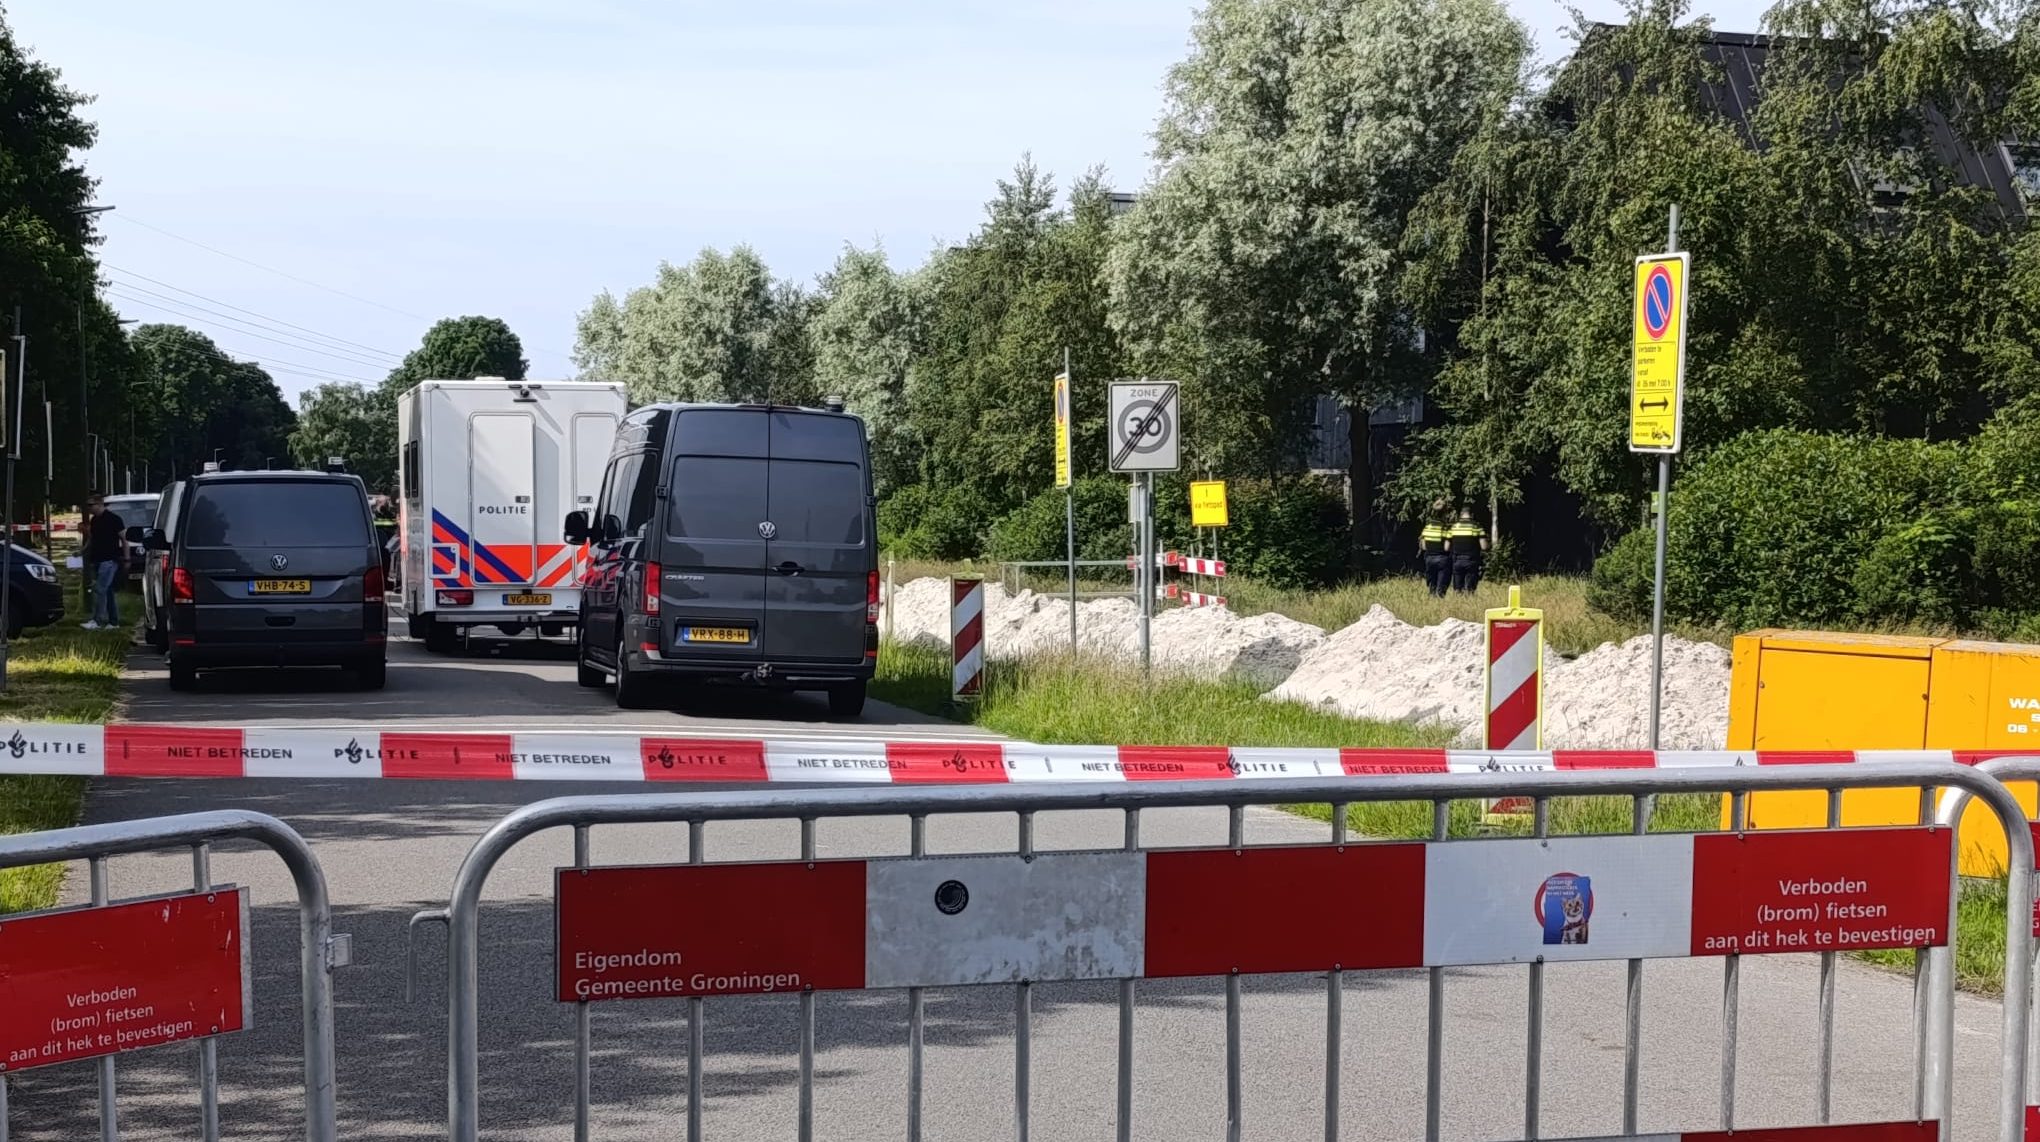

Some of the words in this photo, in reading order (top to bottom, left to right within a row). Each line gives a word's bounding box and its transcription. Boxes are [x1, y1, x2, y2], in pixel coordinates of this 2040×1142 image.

[1130, 388, 1159, 398] ZONE
[1128, 416, 1162, 438] 30
[478, 505, 527, 515] POLITIE
[256, 581, 306, 591] VHB-74-S
[692, 628, 745, 641] VRX-88-H
[168, 746, 202, 758] NIET
[208, 748, 293, 760] BETREDEN
[334, 738, 419, 764] POLITIE
[495, 753, 527, 764] NIET
[533, 754, 612, 765] BETREDEN
[648, 745, 728, 769] POLITIE
[942, 750, 1017, 773] POLITIE
[797, 758, 829, 769] NIET
[833, 759, 908, 770] BETREDEN
[1081, 762, 1111, 772] NIET
[1114, 762, 1185, 773] BETREDEN
[1217, 754, 1289, 776] POLITIE
[1349, 765, 1377, 775] NIET
[1380, 765, 1451, 775] BETREDEN
[1778, 877, 1868, 896] Verboden
[1756, 902, 1820, 924] (brom)
[1825, 901, 1888, 920] fietsen
[1704, 935, 1738, 950] aan
[1744, 930, 1770, 948] dit
[1775, 928, 1809, 947] hek
[1813, 929, 1833, 945] te
[1838, 924, 1937, 945] bevestigen
[575, 948, 682, 973] Eigendom
[574, 975, 684, 996] Gemeente
[690, 971, 800, 992] Groningen
[66, 985, 138, 1008] Verboden
[50, 1010, 101, 1035] (brom)
[105, 1003, 154, 1024] fietsen
[9, 1048, 38, 1063] aan
[41, 1040, 63, 1057] dit
[66, 1037, 94, 1053] hek
[97, 1033, 113, 1047] te
[116, 1019, 193, 1044] bevestigen
